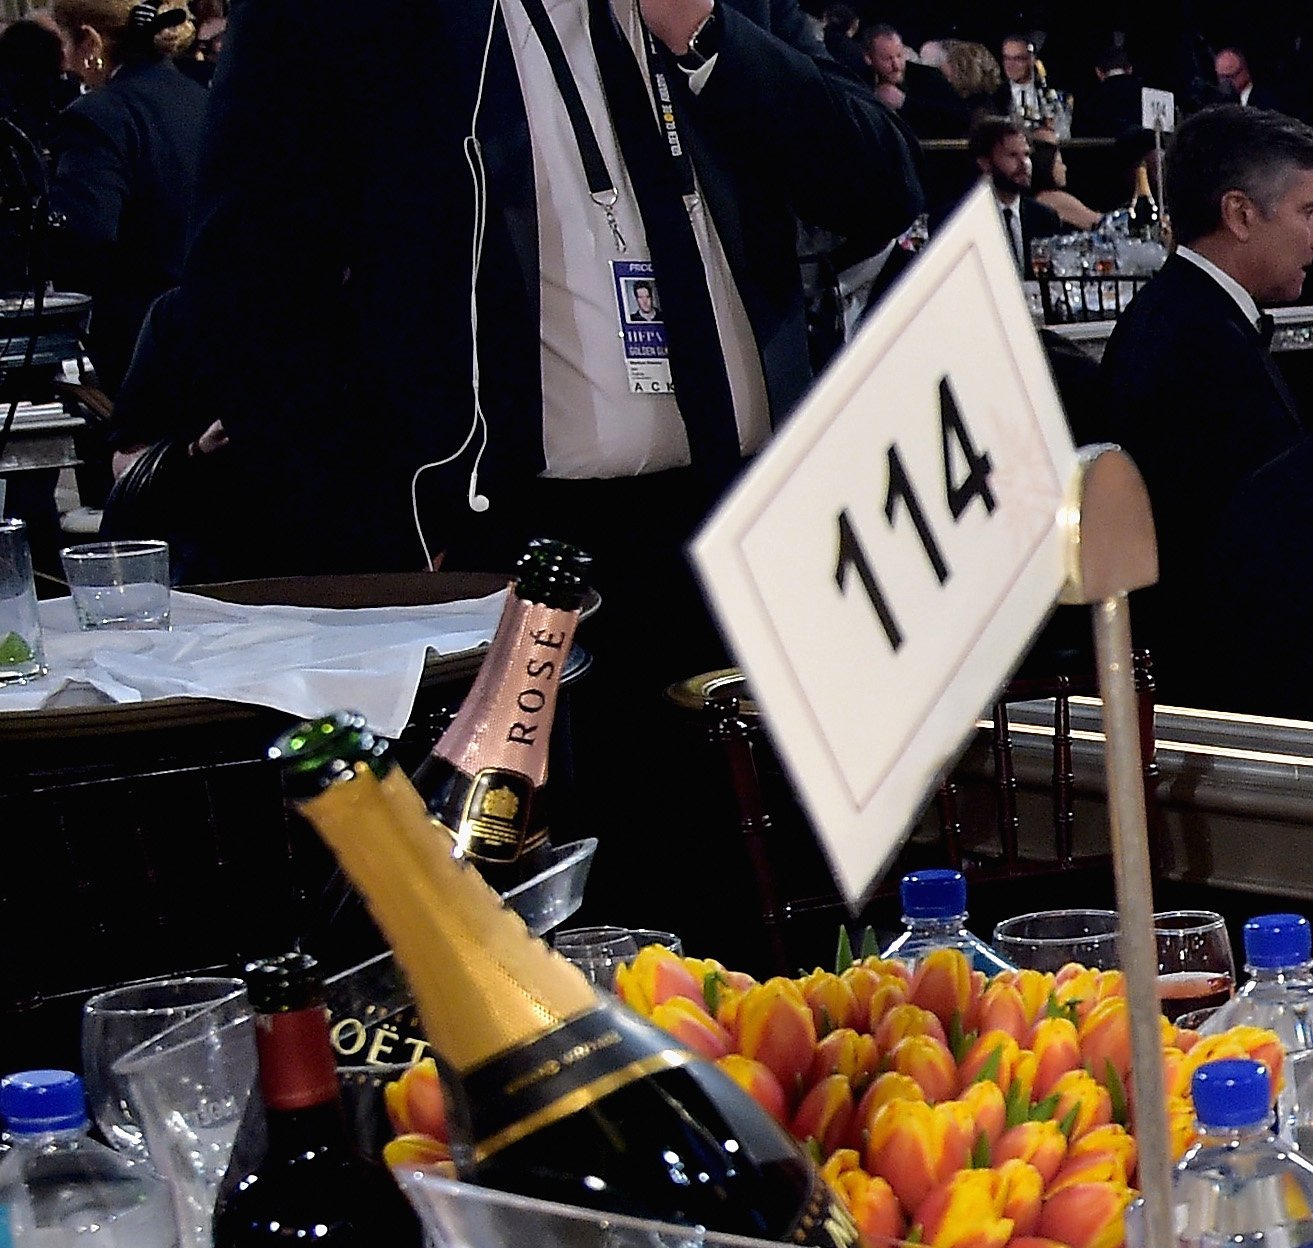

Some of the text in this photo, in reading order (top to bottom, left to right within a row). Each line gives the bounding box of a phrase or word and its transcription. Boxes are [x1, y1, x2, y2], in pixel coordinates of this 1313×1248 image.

[832, 373, 997, 653] 114
[507, 628, 566, 746] ROSÉ
[327, 1014, 431, 1067] OËT
